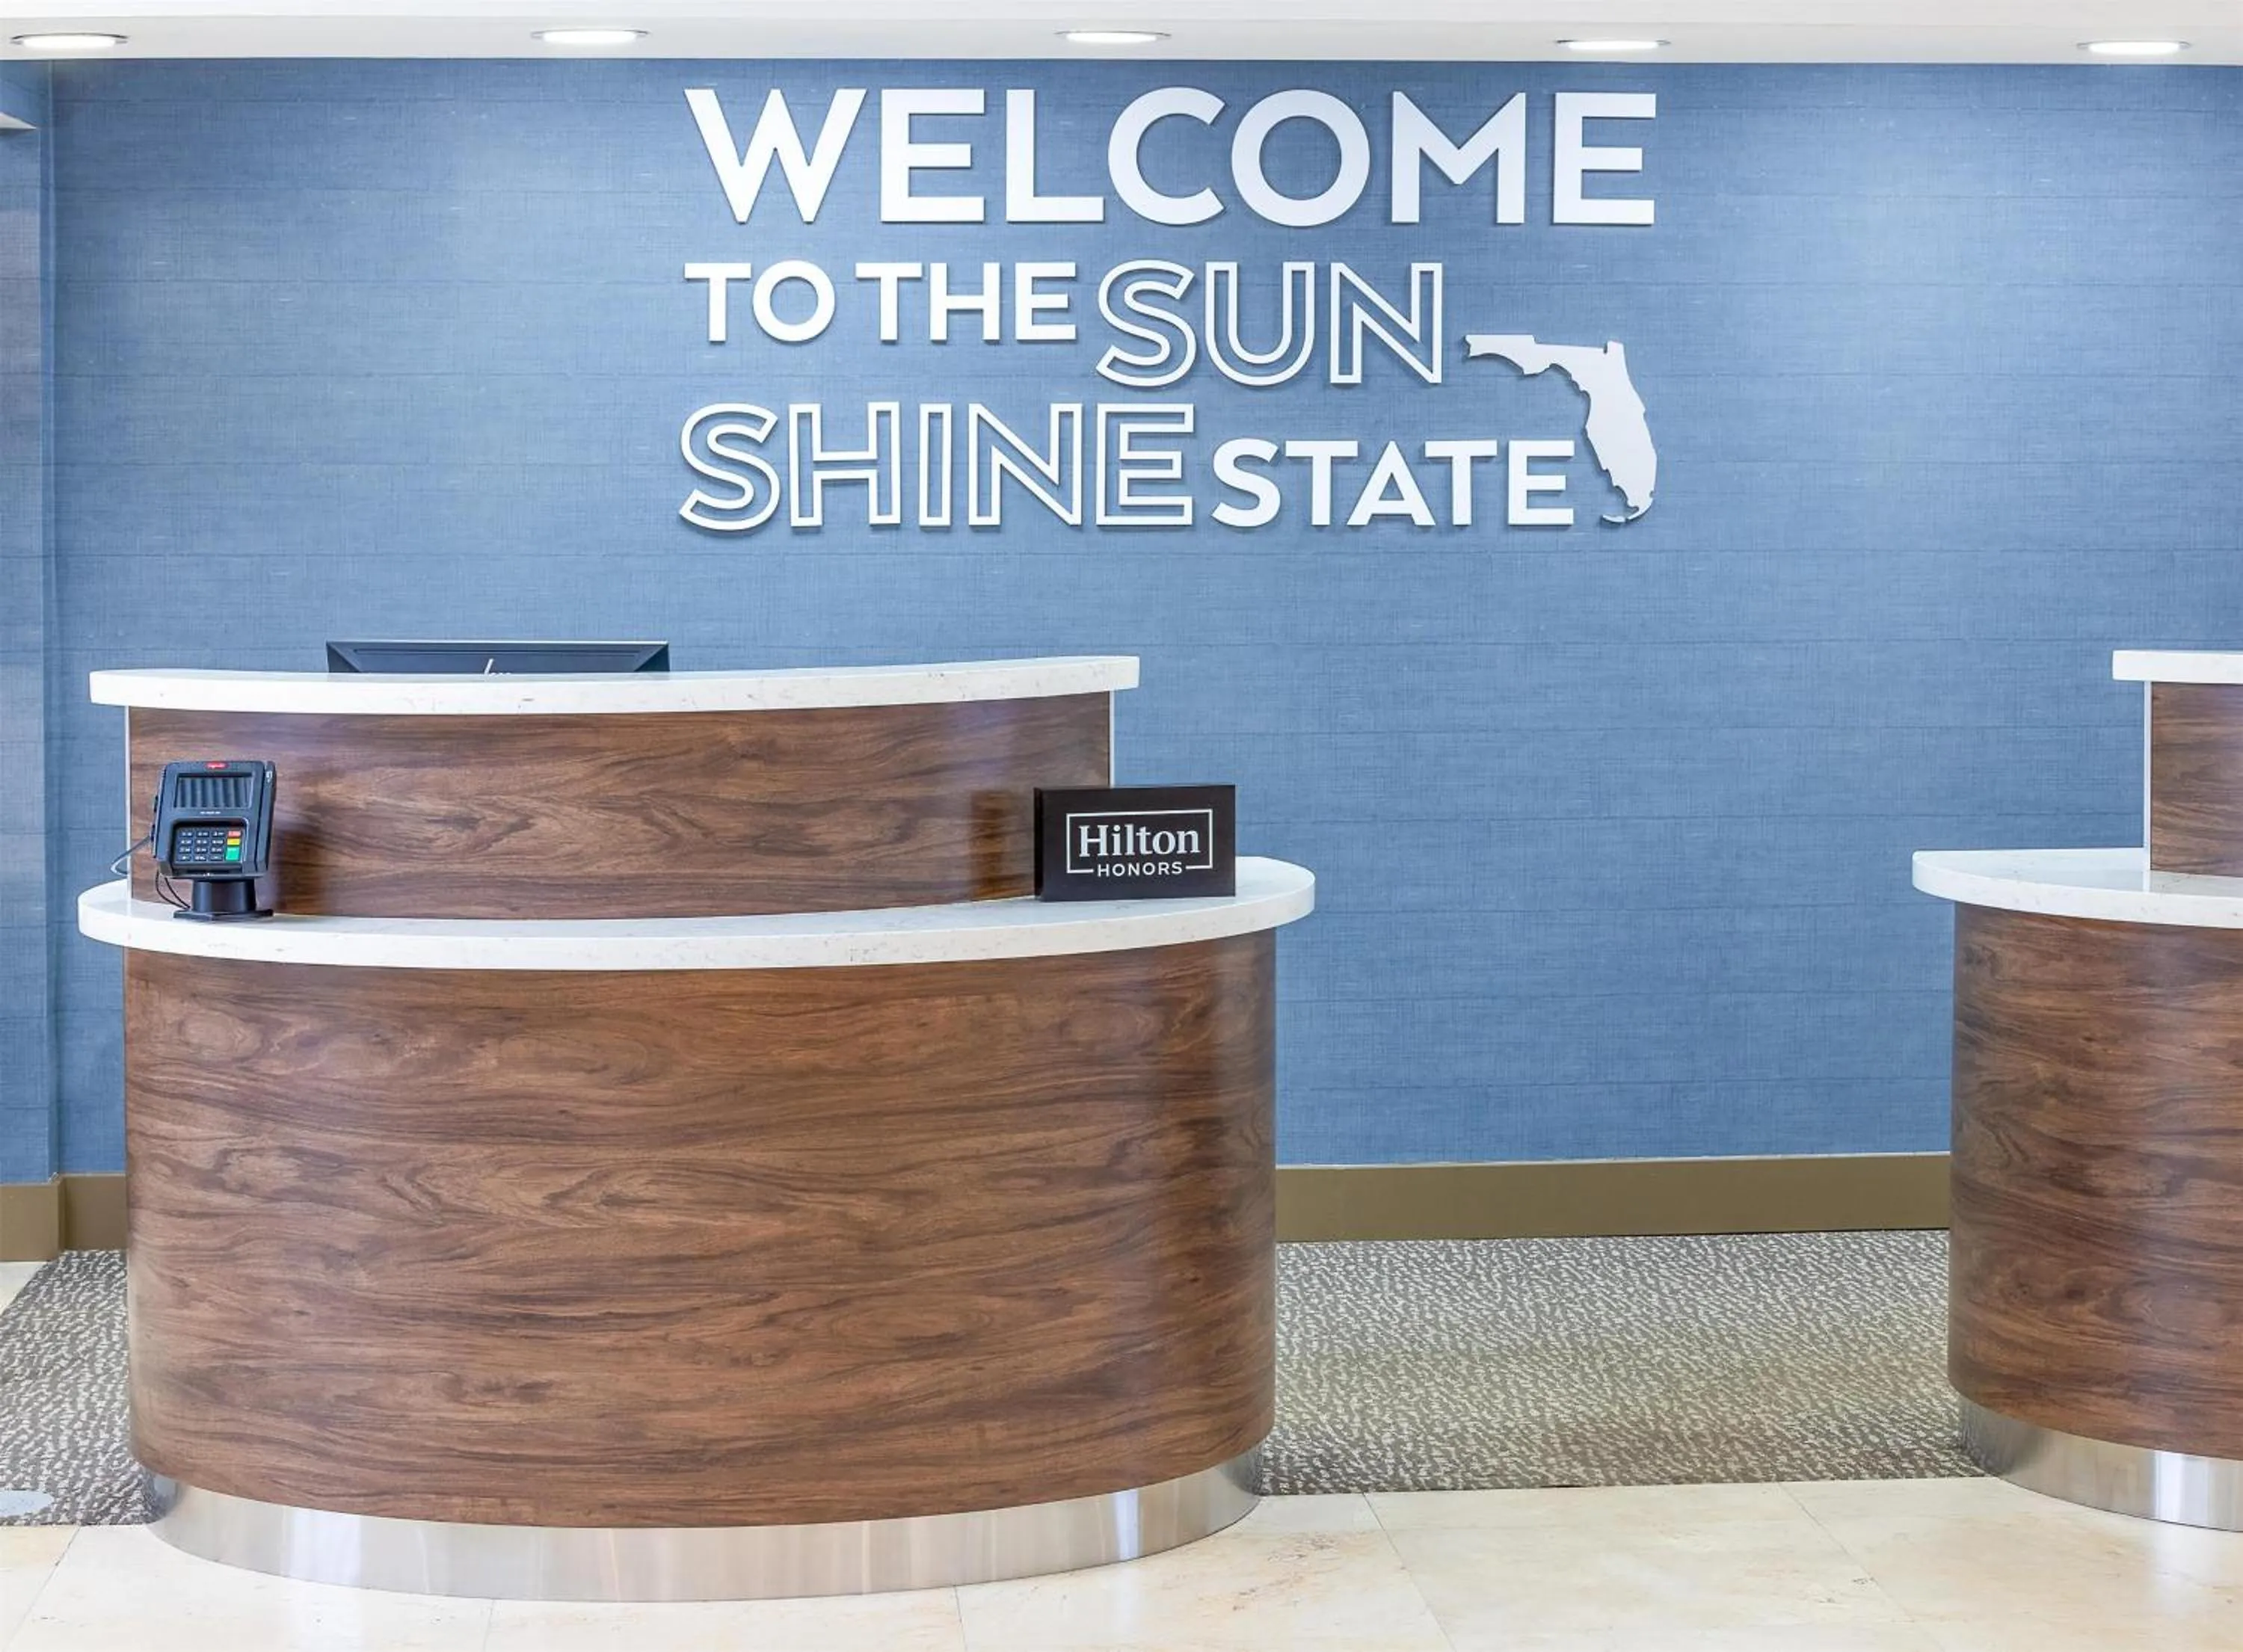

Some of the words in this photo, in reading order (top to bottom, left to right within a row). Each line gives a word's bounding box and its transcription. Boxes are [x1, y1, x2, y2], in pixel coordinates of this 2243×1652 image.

[683, 87, 1657, 227] WELCOME
[684, 259, 836, 343] TO
[855, 262, 1077, 342] THE
[1095, 259, 1443, 388] SUN
[679, 401, 1195, 531] SHINE
[1210, 438, 1575, 528] STATE
[1078, 824, 1201, 857] Hilton
[1097, 861, 1183, 878] HONORS
